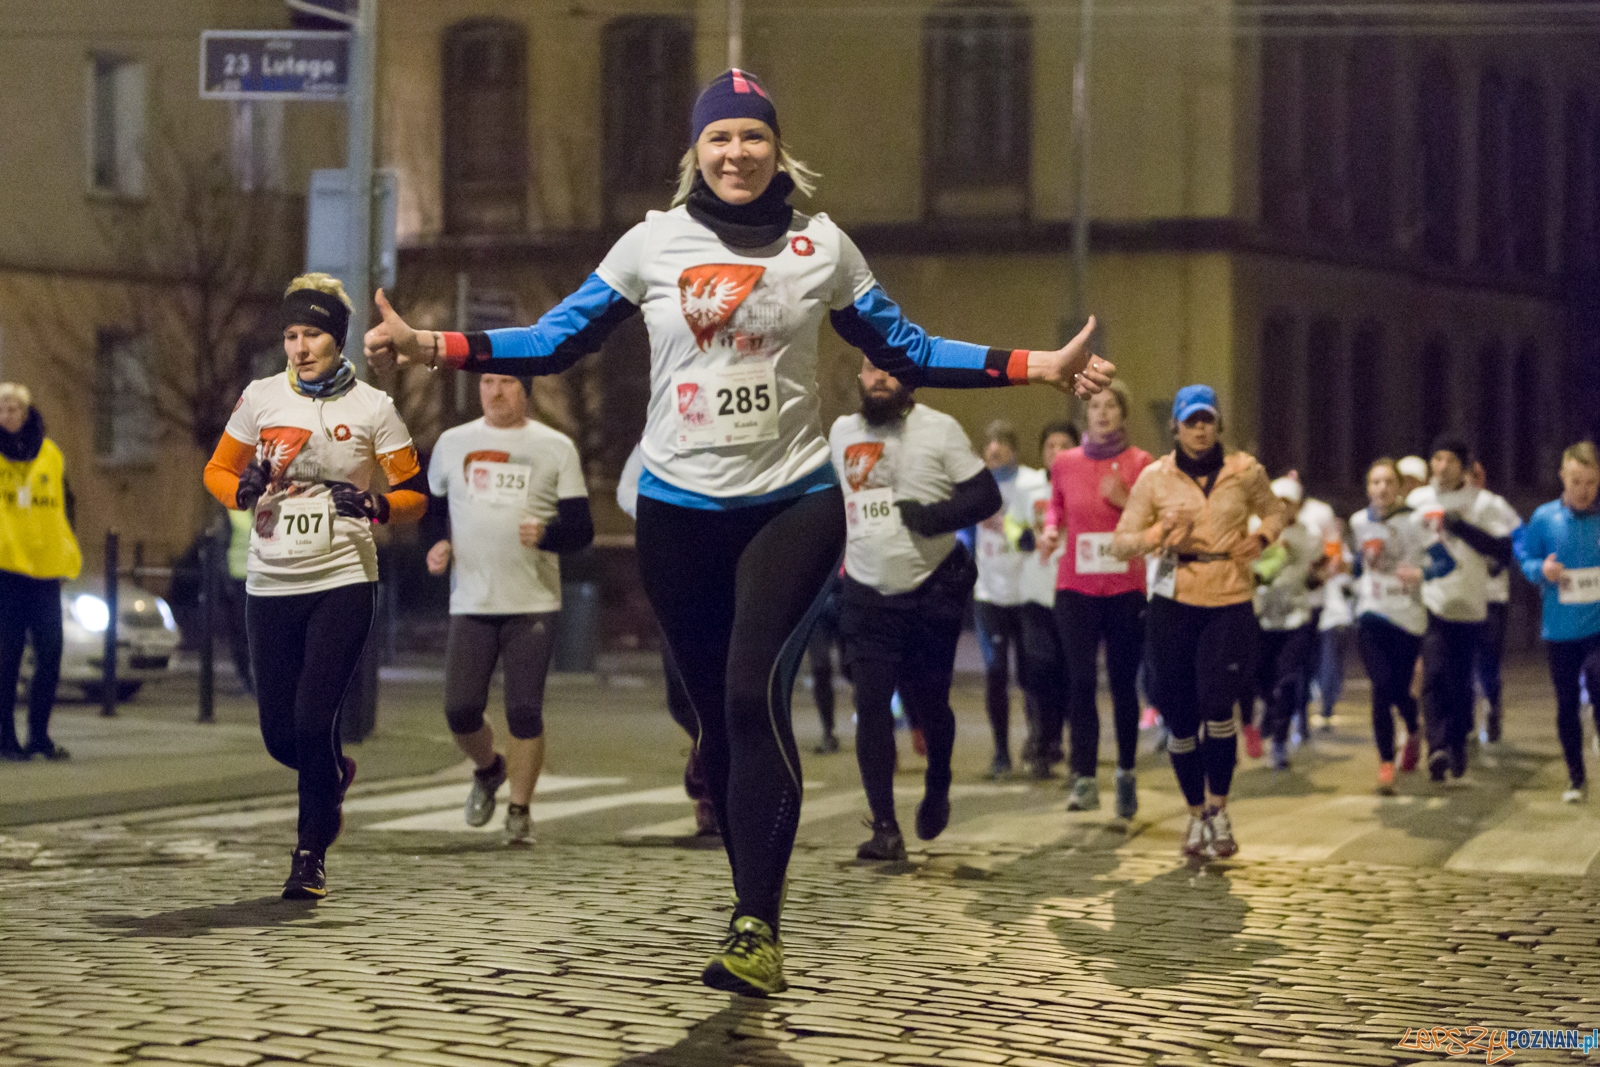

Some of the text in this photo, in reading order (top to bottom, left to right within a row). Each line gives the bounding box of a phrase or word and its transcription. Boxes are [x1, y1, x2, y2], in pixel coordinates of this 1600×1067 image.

[223, 53, 336, 79] 23 Lutego
[716, 383, 770, 416] 285
[495, 472, 525, 490] 325
[861, 501, 890, 519] 166
[283, 513, 323, 535] 707
